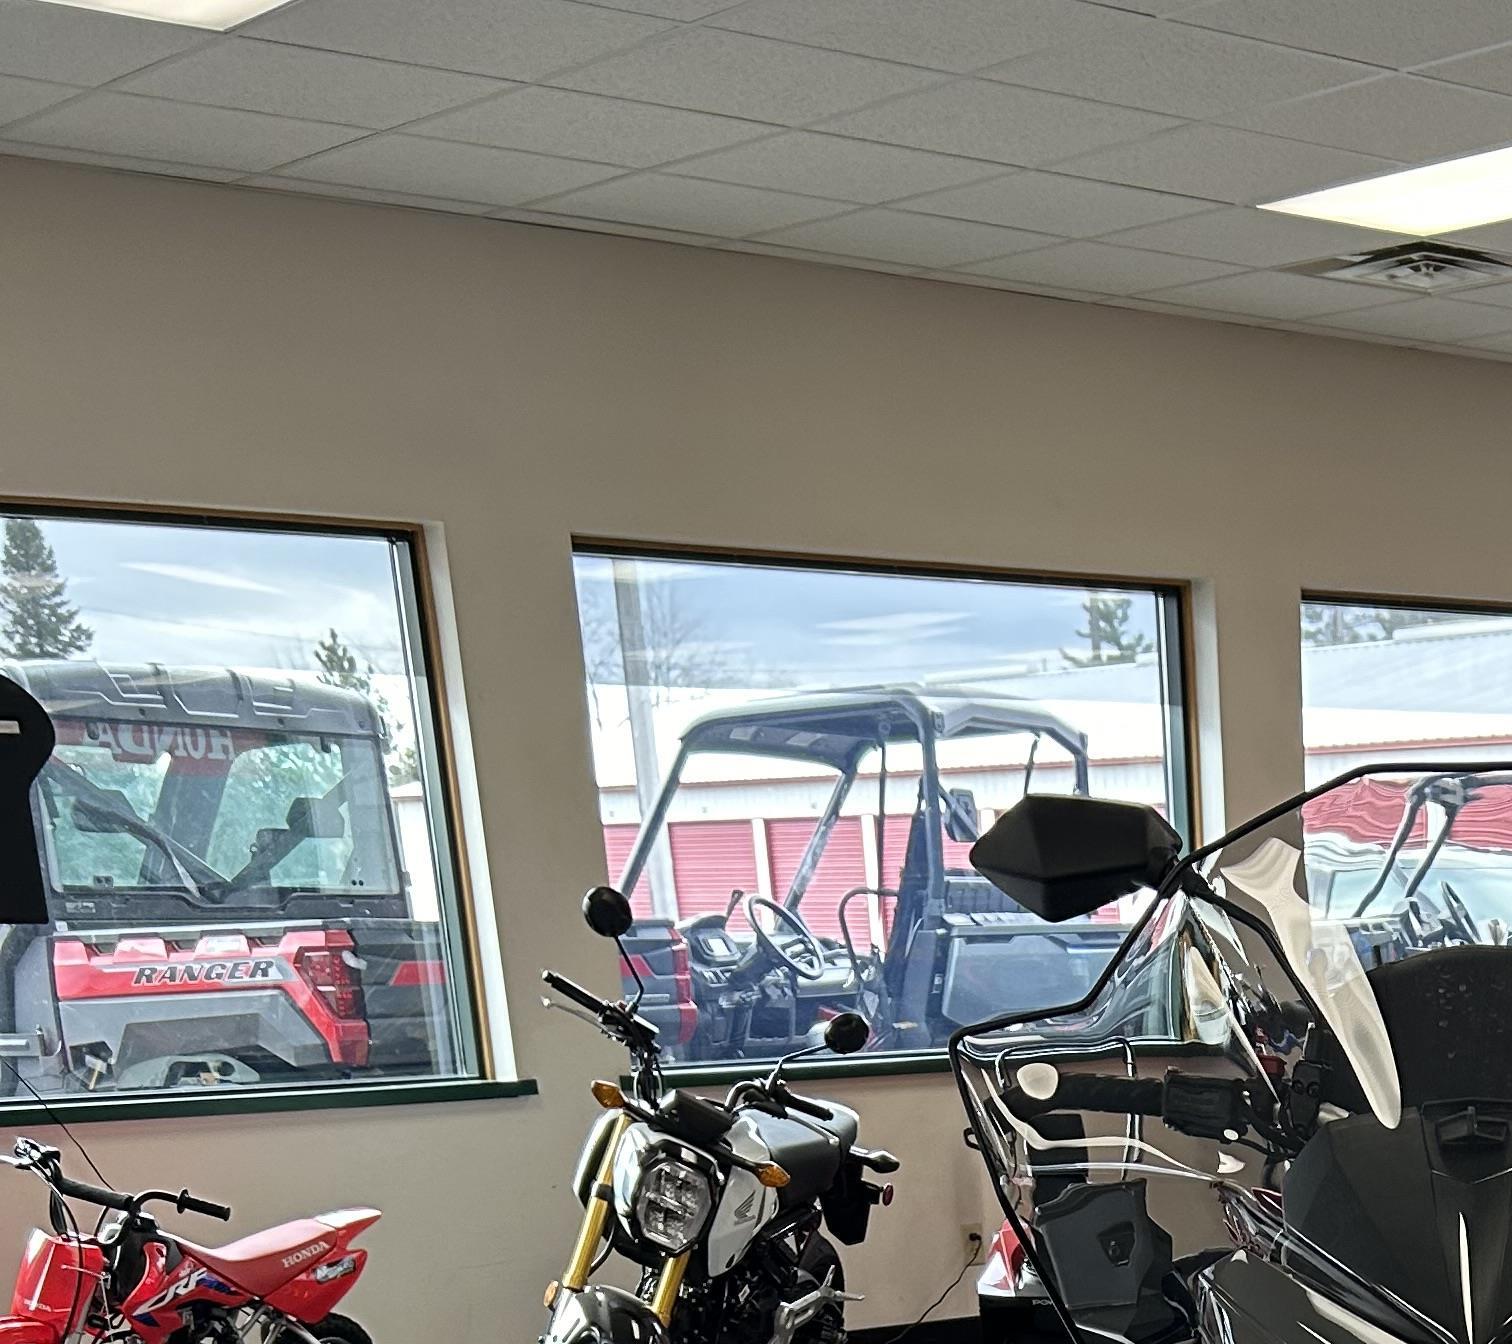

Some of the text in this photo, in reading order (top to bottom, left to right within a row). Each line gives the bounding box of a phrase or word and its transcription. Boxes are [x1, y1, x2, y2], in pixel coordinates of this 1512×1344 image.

[133, 960, 275, 986] RANGER
[282, 1240, 330, 1269] HONDA
[133, 1267, 208, 1316] CRF
